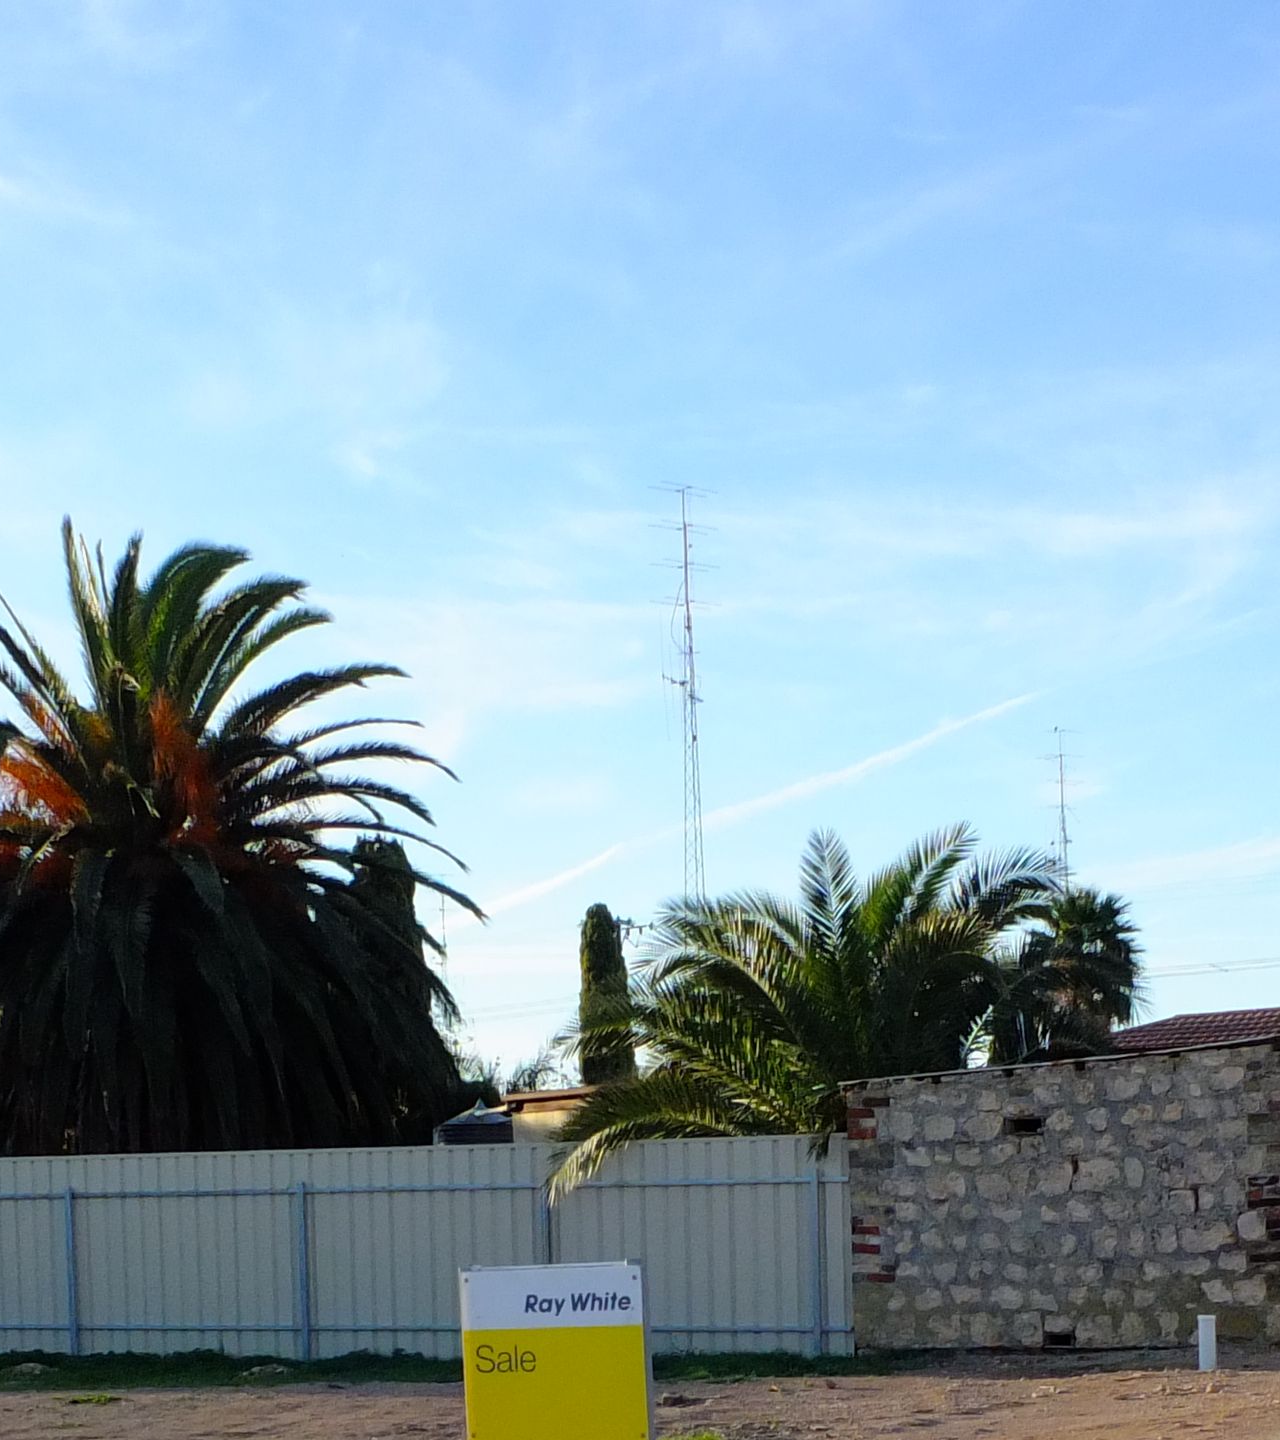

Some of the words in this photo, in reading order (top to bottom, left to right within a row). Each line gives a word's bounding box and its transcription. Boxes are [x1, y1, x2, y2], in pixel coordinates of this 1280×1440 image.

[524, 1294, 565, 1316] Ray
[571, 1292, 631, 1312] White
[476, 1344, 537, 1374] Sale
